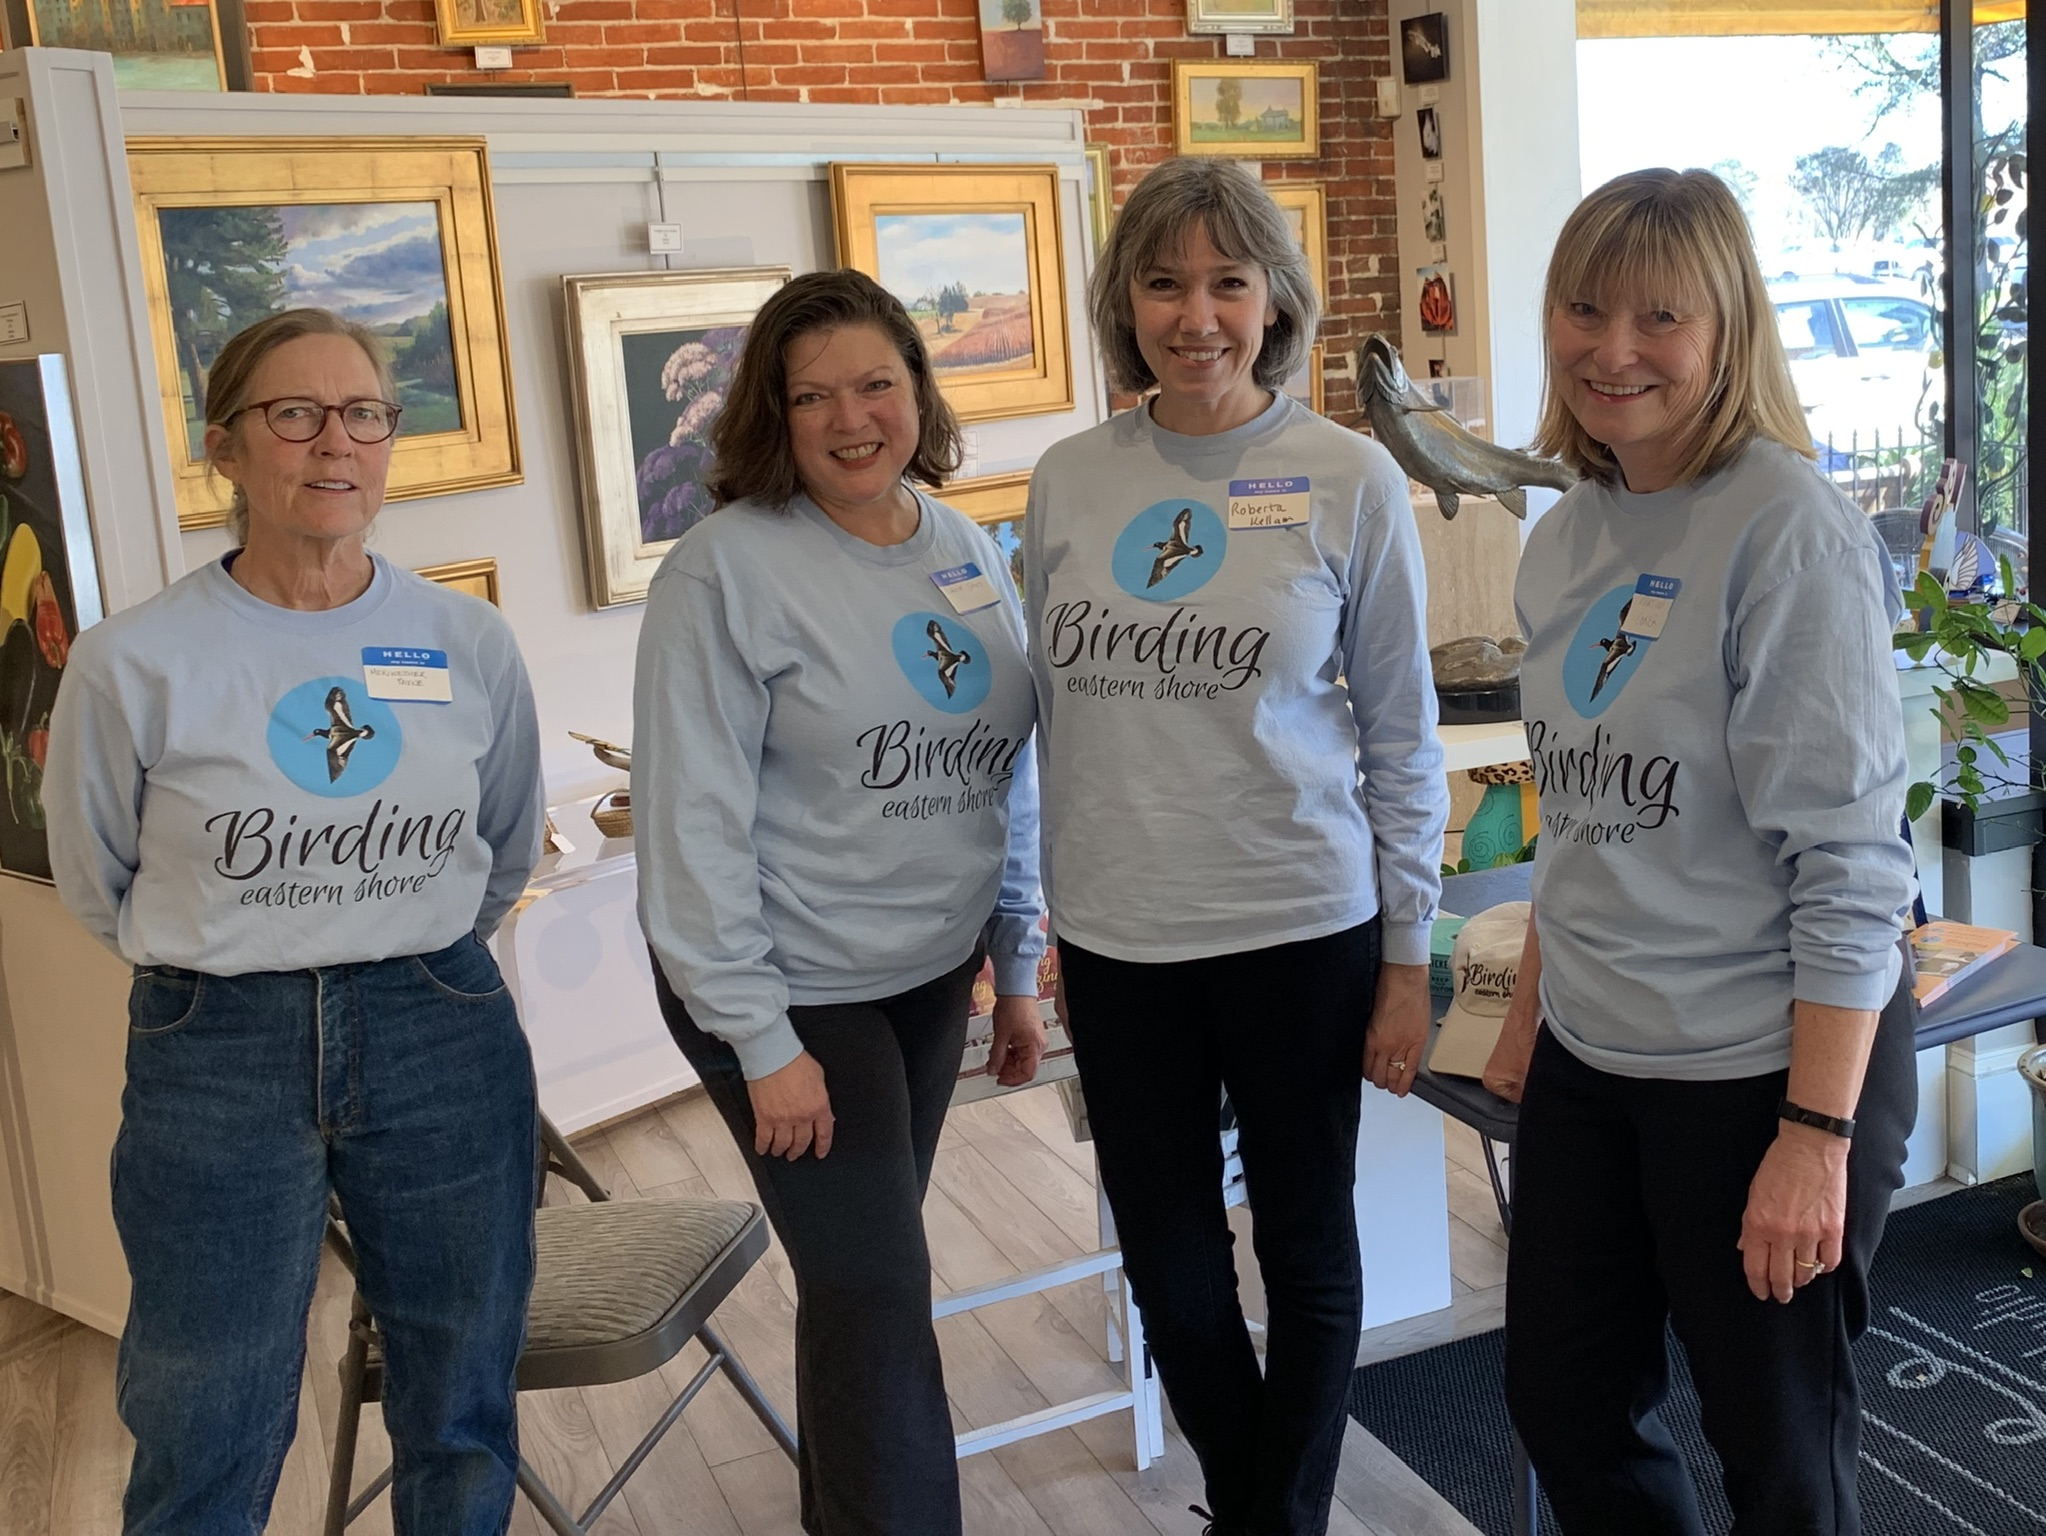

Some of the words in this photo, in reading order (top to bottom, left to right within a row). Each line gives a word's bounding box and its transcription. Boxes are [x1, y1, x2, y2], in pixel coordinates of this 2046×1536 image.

[1248, 481, 1293, 489] HELLO
[1231, 502, 1287, 516] Roberta
[1250, 514, 1294, 526] Kellam
[941, 568, 968, 580] HELLO
[1649, 580, 1674, 590] HELLO
[1046, 600, 1271, 690] Birding
[382, 651, 431, 660] HELLO
[1067, 674, 1144, 699] eastern
[1154, 674, 1219, 700] shore
[882, 795, 952, 820] eastern
[958, 786, 994, 814] shore
[205, 799, 466, 880] Birding
[240, 882, 343, 909] eastern
[354, 872, 426, 903] shore
[1430, 959, 1448, 969] ICKE
